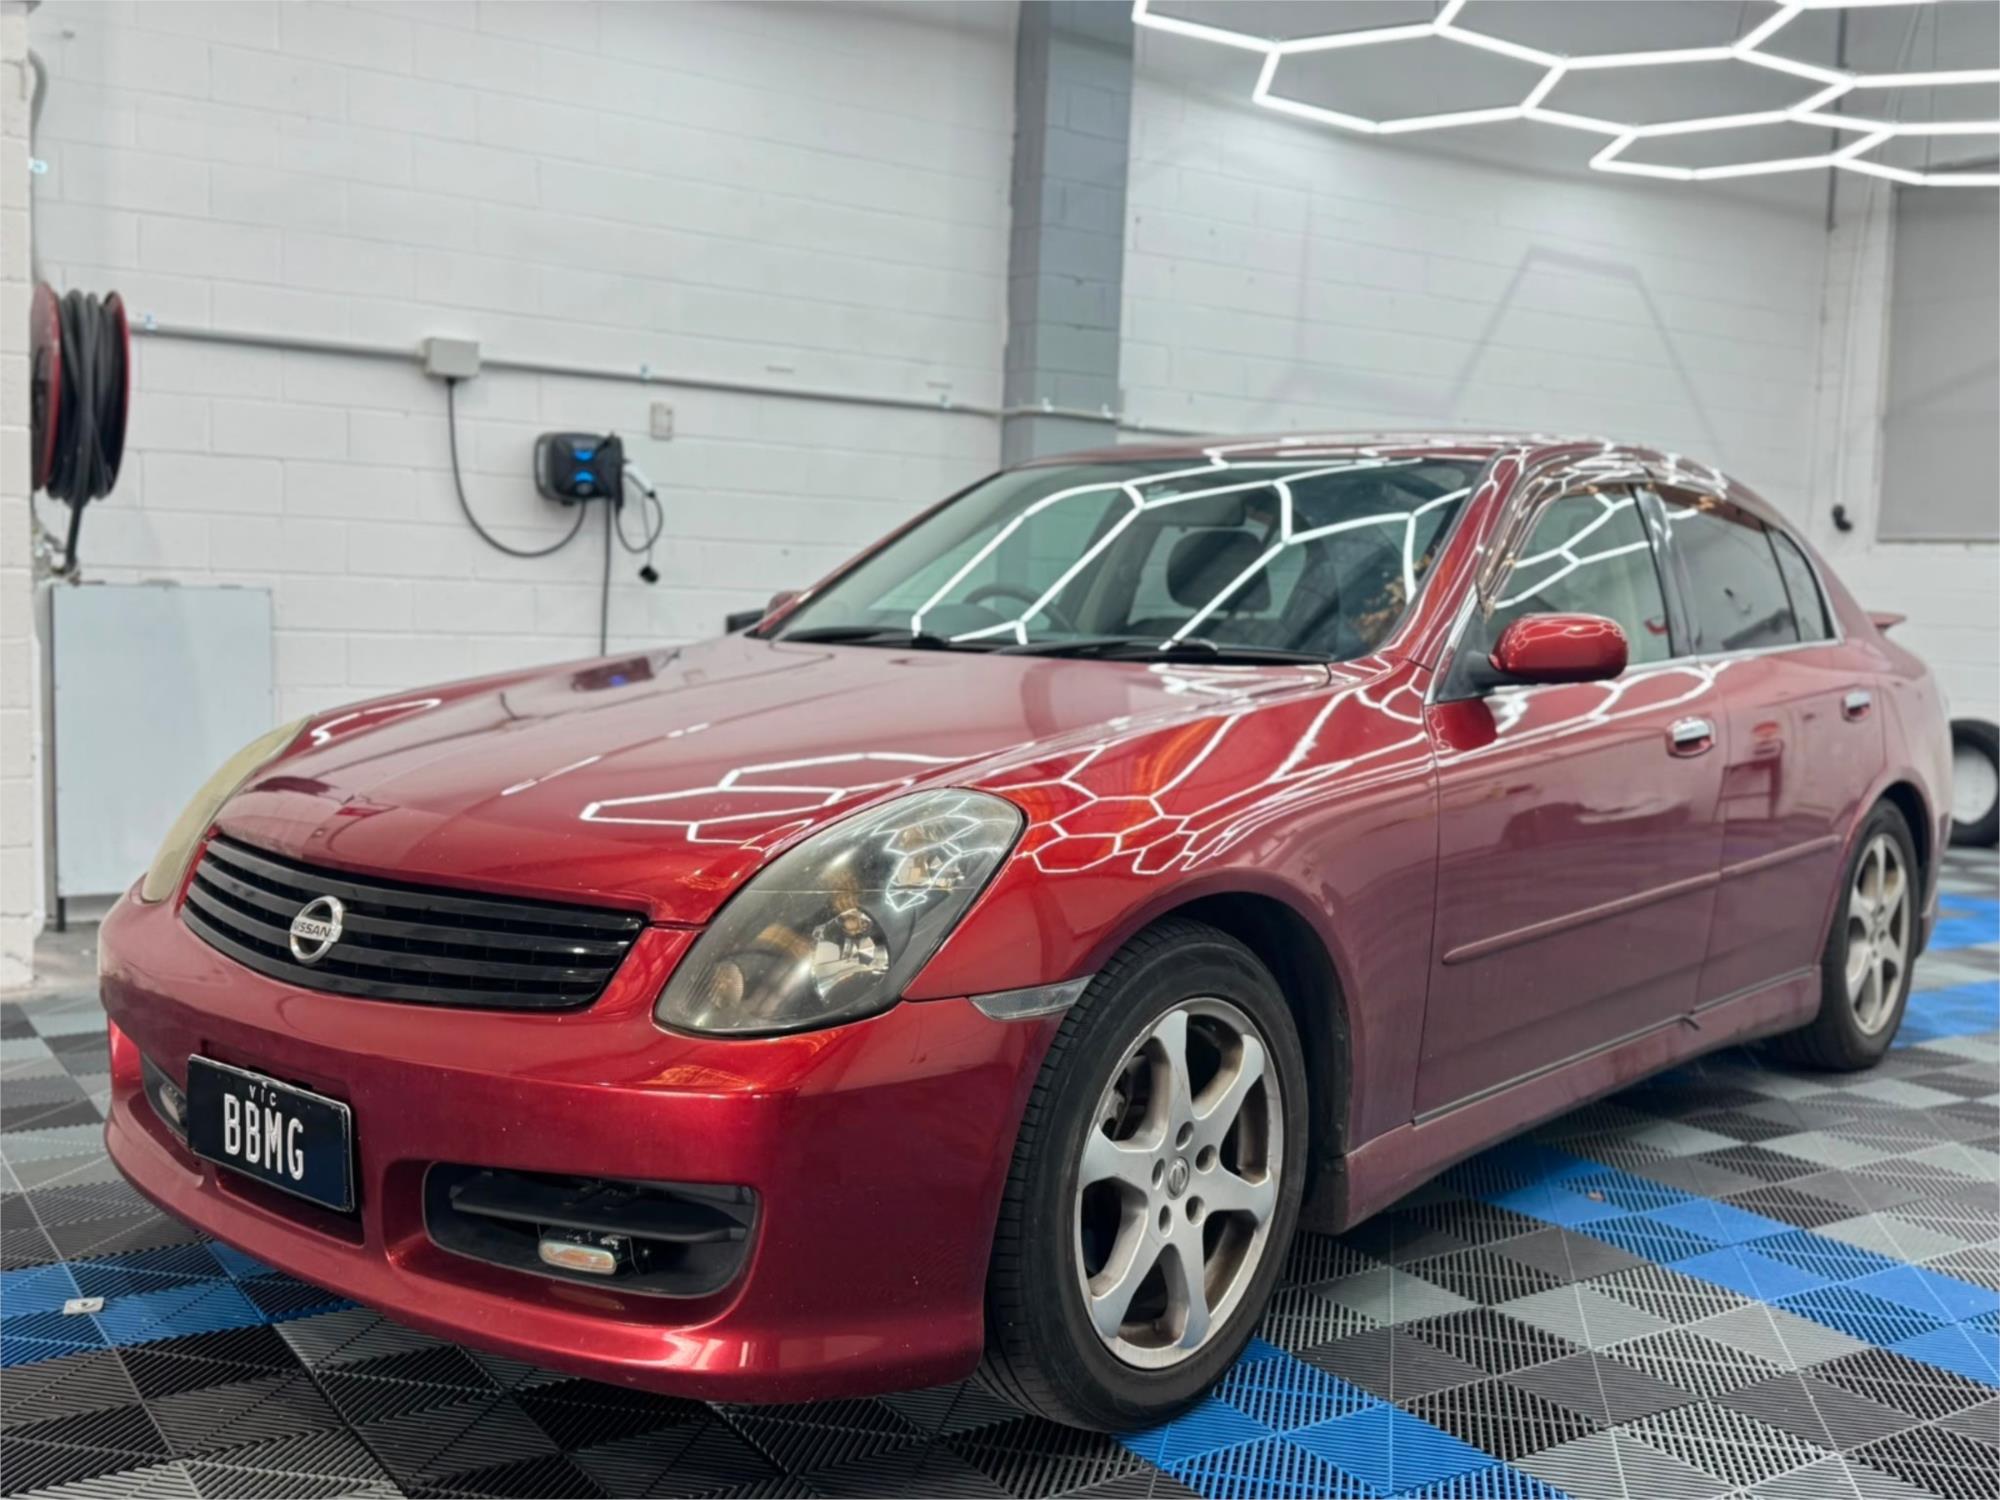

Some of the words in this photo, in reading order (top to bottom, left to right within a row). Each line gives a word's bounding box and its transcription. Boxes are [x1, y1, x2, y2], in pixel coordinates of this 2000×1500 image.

[294, 919, 332, 938] SSAN
[249, 1084, 277, 1107] VIC
[224, 1093, 304, 1181] BBMG
